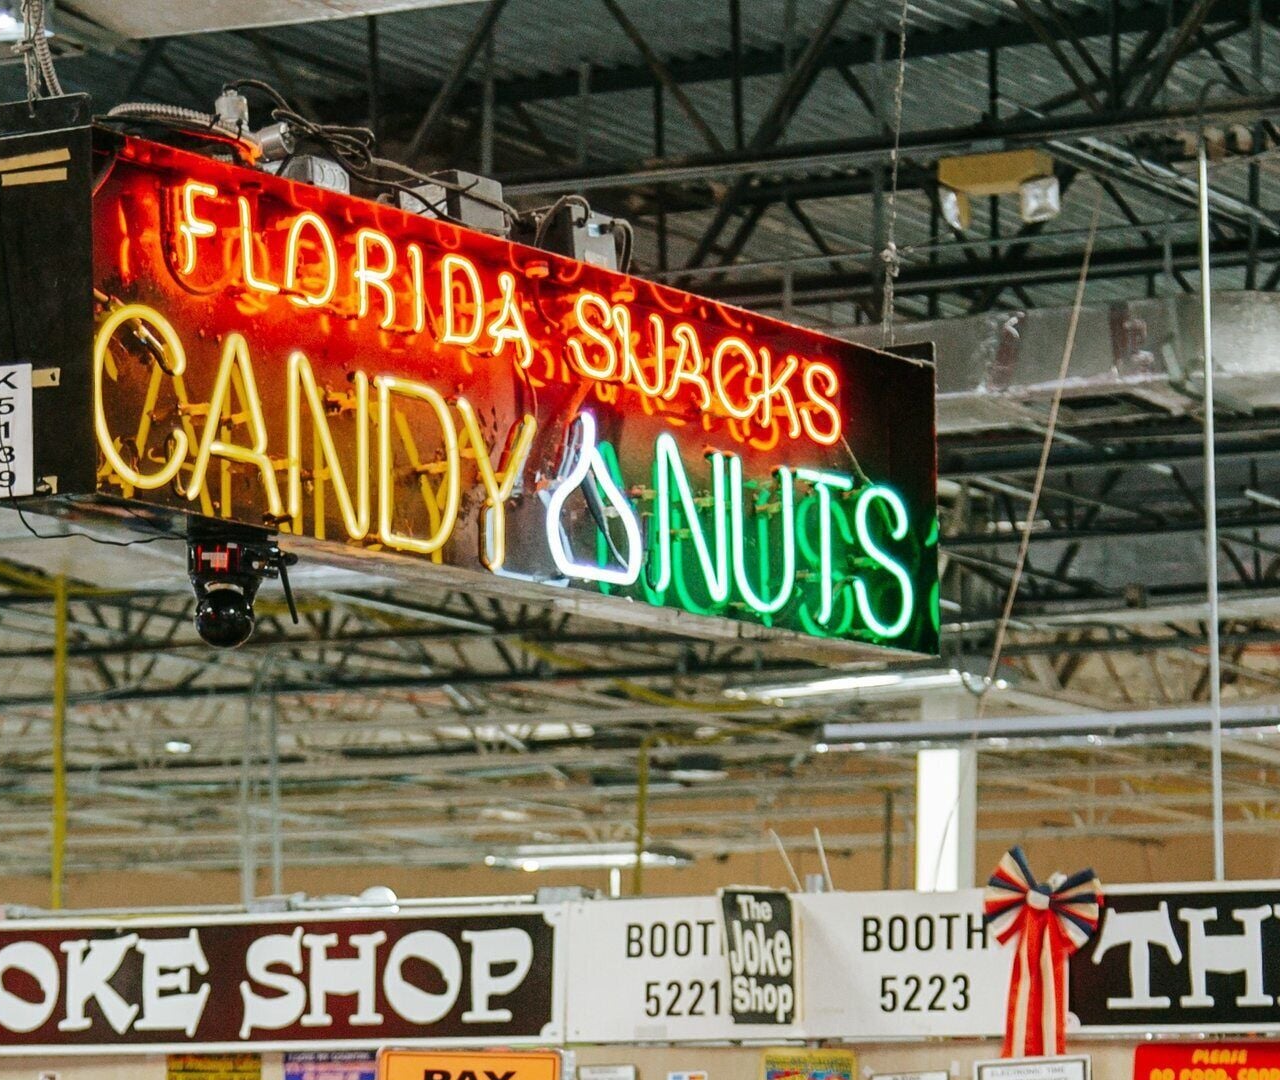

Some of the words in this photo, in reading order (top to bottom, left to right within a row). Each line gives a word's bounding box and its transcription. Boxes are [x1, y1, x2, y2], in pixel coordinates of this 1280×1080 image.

[177, 180, 533, 369] FLORIDA
[566, 292, 843, 447] SNACKS
[93, 303, 538, 573] CANDY
[654, 432, 915, 639] NUTS
[737, 895, 773, 922] The
[626, 919, 724, 958] BOOT
[729, 921, 793, 977] Joke
[862, 912, 990, 952] BOOTH
[239, 925, 535, 1041] SHOP
[645, 980, 721, 1017] 5221
[732, 977, 794, 1023] Shop
[880, 974, 971, 1013] 5223
[1047, 1065, 1066, 1074] TIME
[1191, 1048, 1248, 1065] PLEASE
